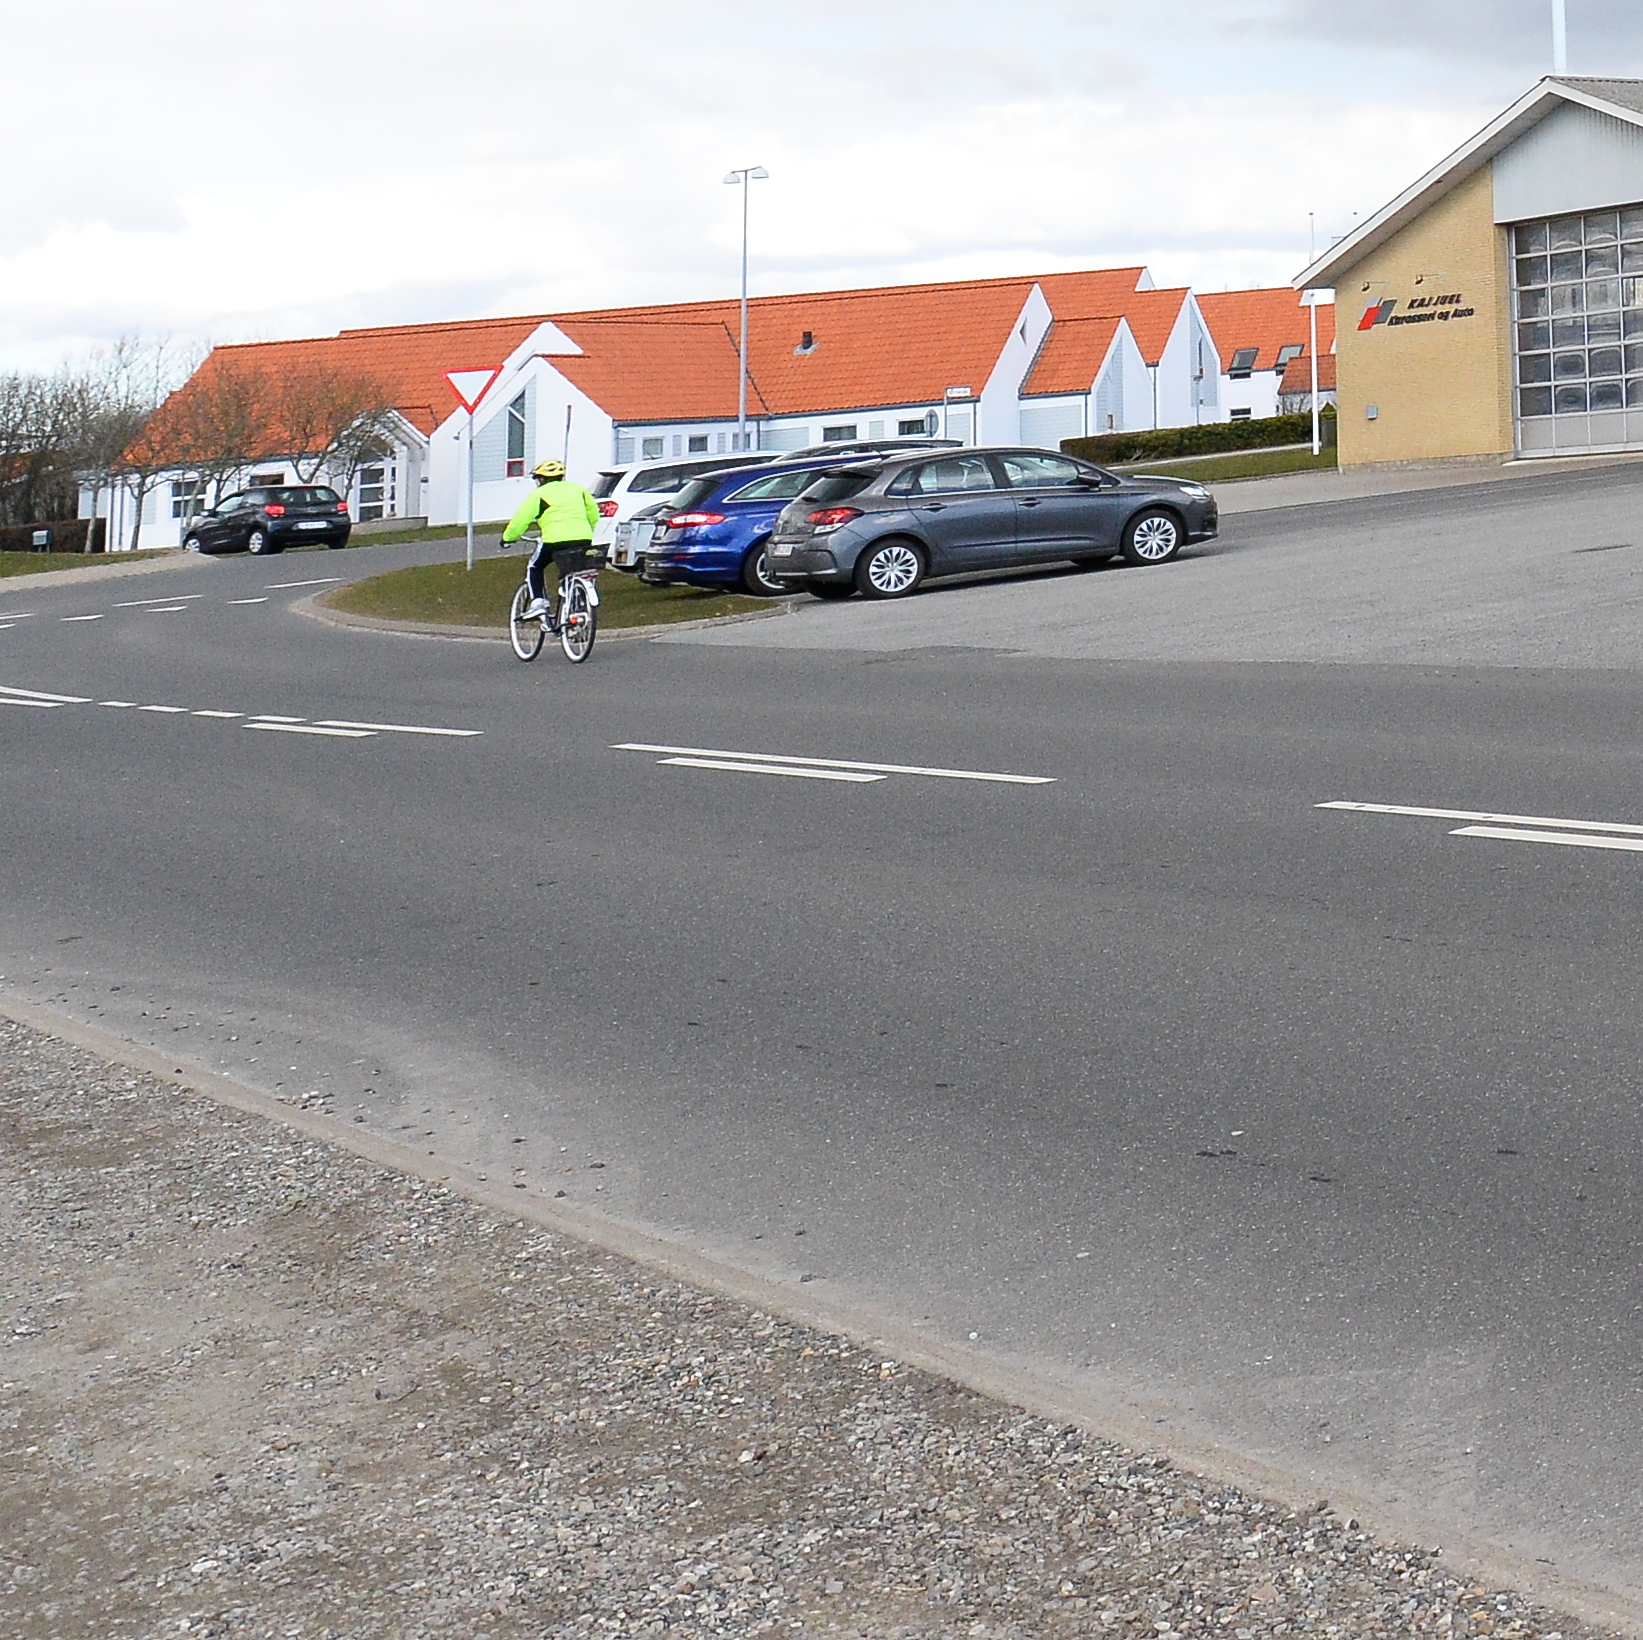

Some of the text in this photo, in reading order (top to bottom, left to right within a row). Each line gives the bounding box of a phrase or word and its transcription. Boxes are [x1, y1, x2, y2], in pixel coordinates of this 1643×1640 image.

[1407, 293, 1462, 309] KAJ JUEL
[1451, 307, 1475, 318] Auto
